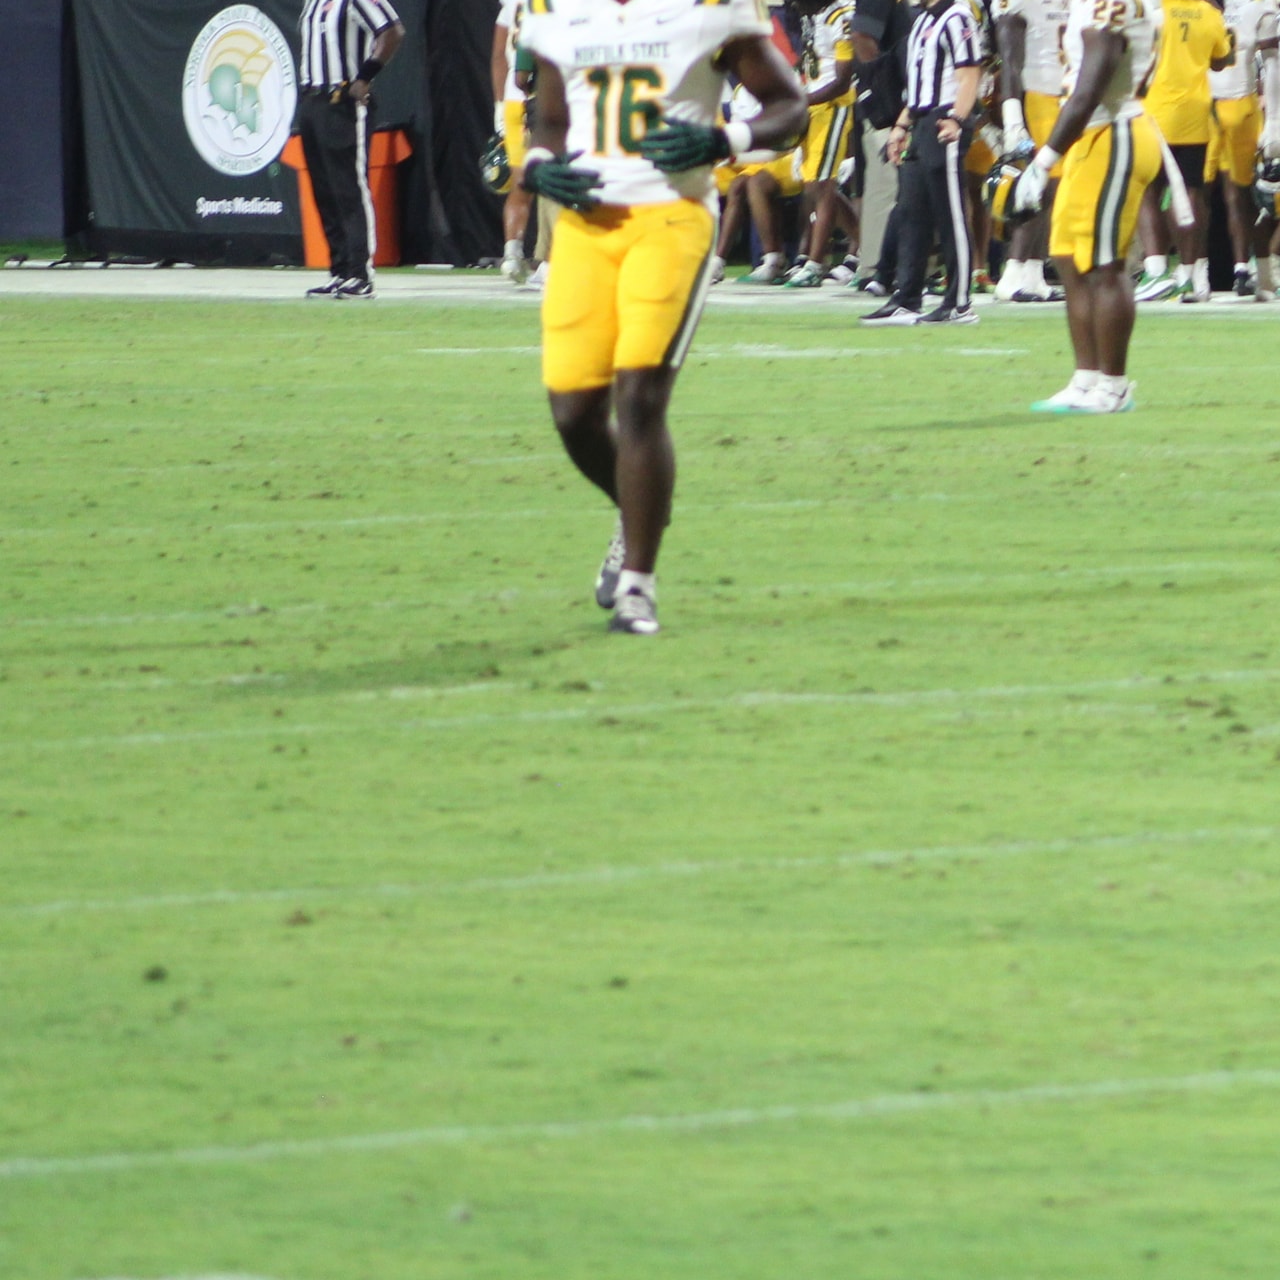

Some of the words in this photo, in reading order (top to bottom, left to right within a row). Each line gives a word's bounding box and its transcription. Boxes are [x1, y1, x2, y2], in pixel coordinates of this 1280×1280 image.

[573, 42, 627, 63] NORFOLK
[631, 39, 671, 60] STATE
[586, 65, 666, 157] 16
[196, 196, 233, 219] Sports
[234, 195, 283, 216] Medicine
